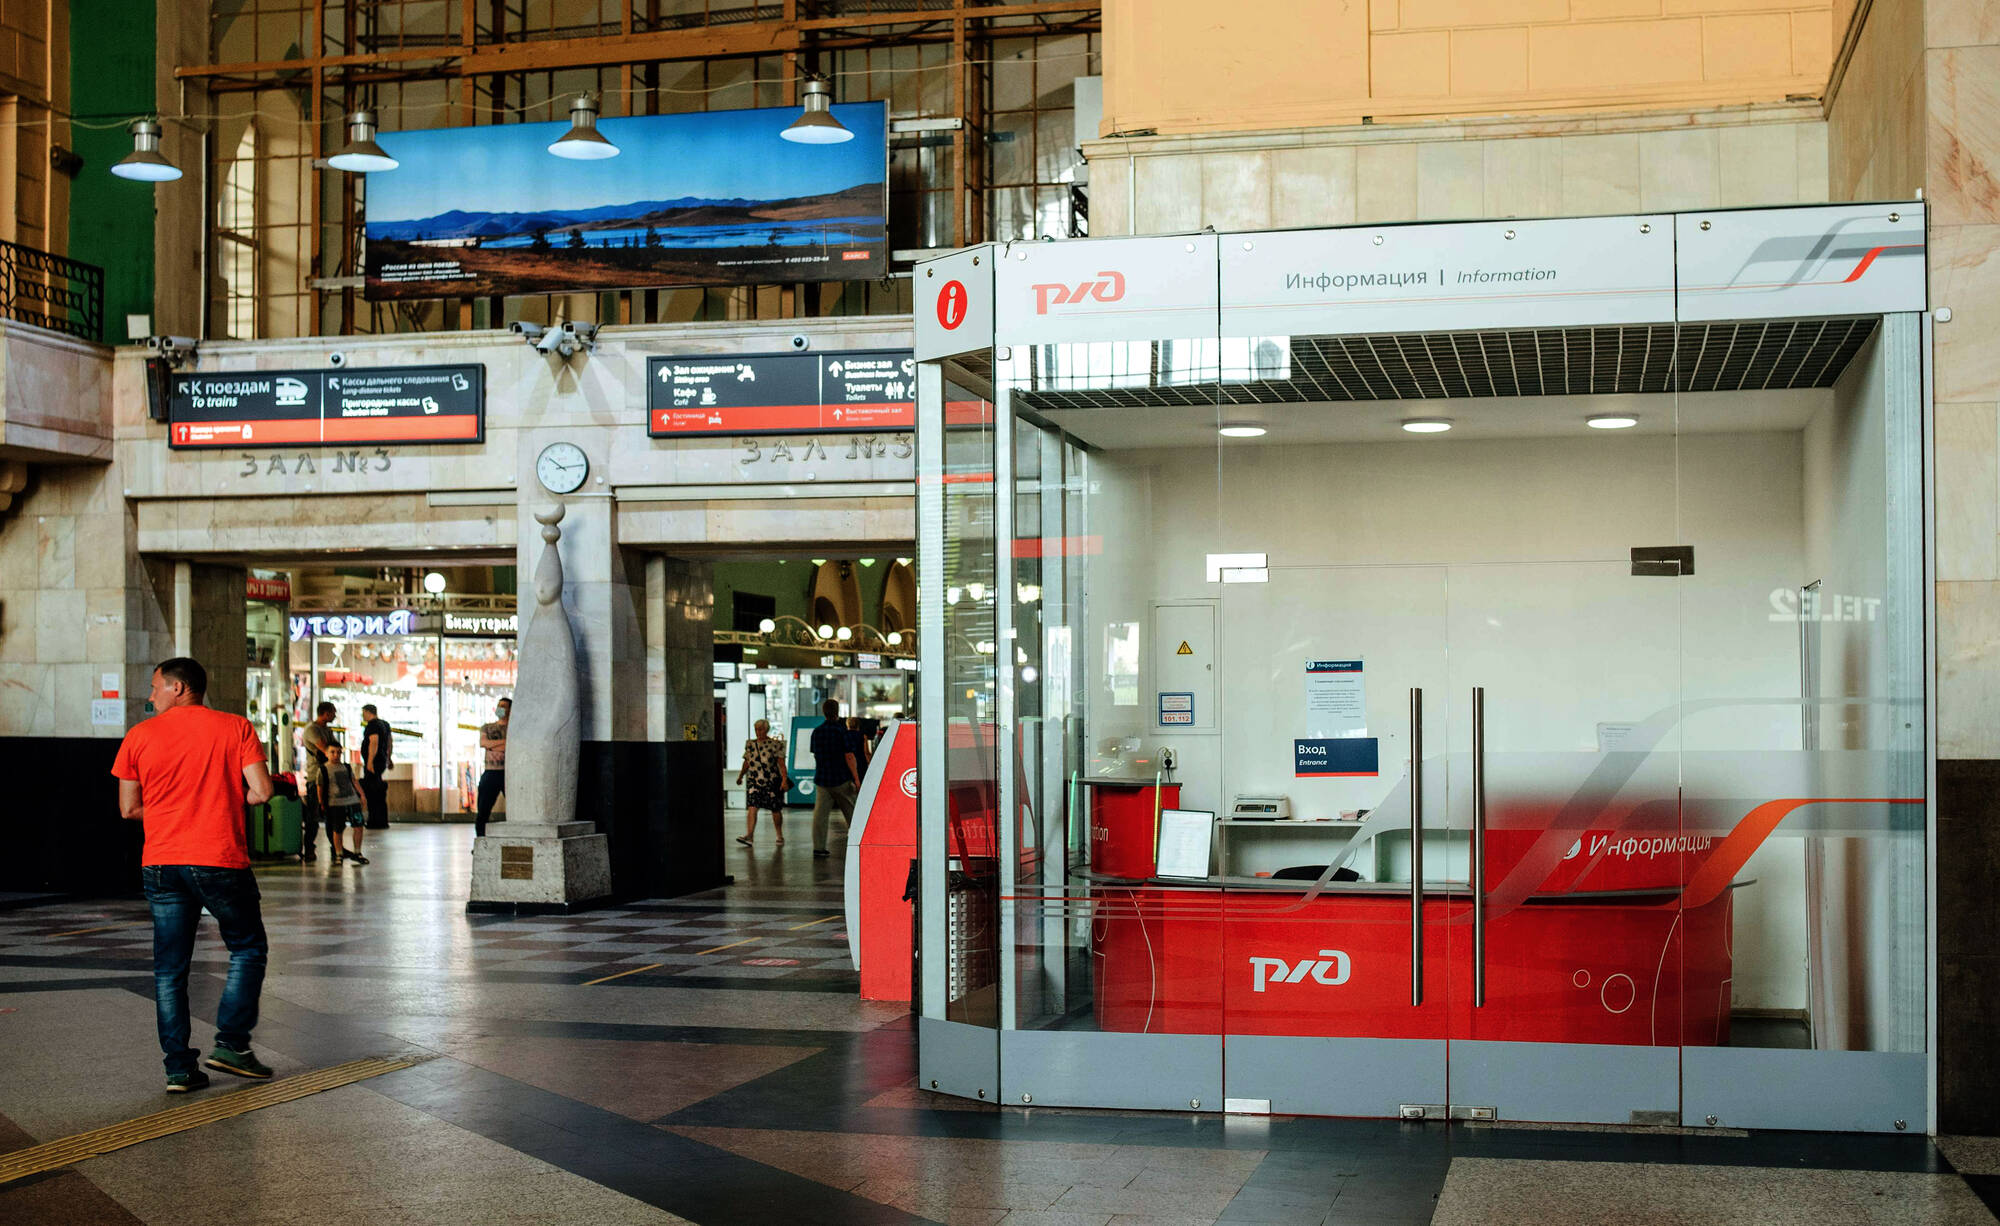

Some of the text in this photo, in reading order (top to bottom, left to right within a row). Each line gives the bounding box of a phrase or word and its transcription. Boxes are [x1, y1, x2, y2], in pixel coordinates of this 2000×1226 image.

[1286, 268, 1556, 291] Информация Information
[673, 365, 690, 375] Зал
[844, 360, 876, 369] Бизнес
[342, 375, 450, 387] Кассы дальнего следования
[192, 380, 270, 396] К поездам
[673, 388, 697, 398] Кафе
[845, 383, 883, 393] Туалеты
[192, 395, 238, 408] To trains
[741, 438, 827, 465] ЗАЛ
[241, 453, 316, 478] ЗАЛ
[1298, 745, 1327, 756] Вход
[1588, 835, 1711, 861] Информация
